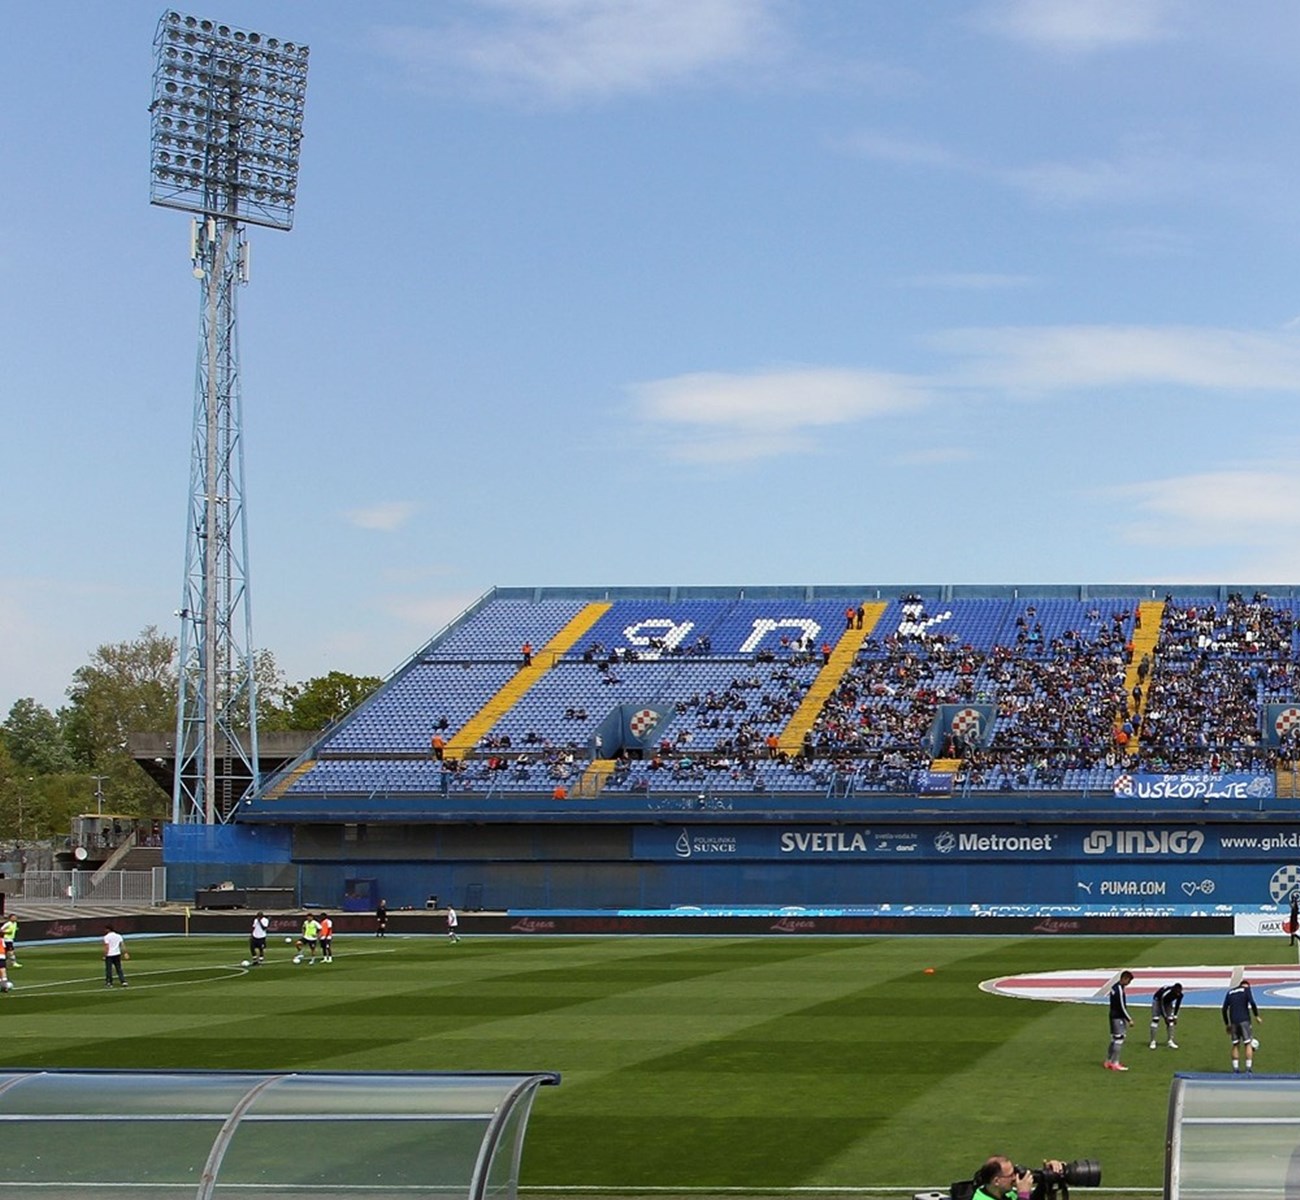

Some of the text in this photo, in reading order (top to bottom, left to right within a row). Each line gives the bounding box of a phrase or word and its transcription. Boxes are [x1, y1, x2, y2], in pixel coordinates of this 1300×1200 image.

[1137, 781, 1248, 799] USKOPLJE
[693, 843, 737, 852] SUNCE
[780, 832, 868, 852] SVETLA
[958, 833, 1052, 852] Metronet
[1100, 881, 1166, 895] PUMA.COM
[1260, 922, 1281, 932] MAX
